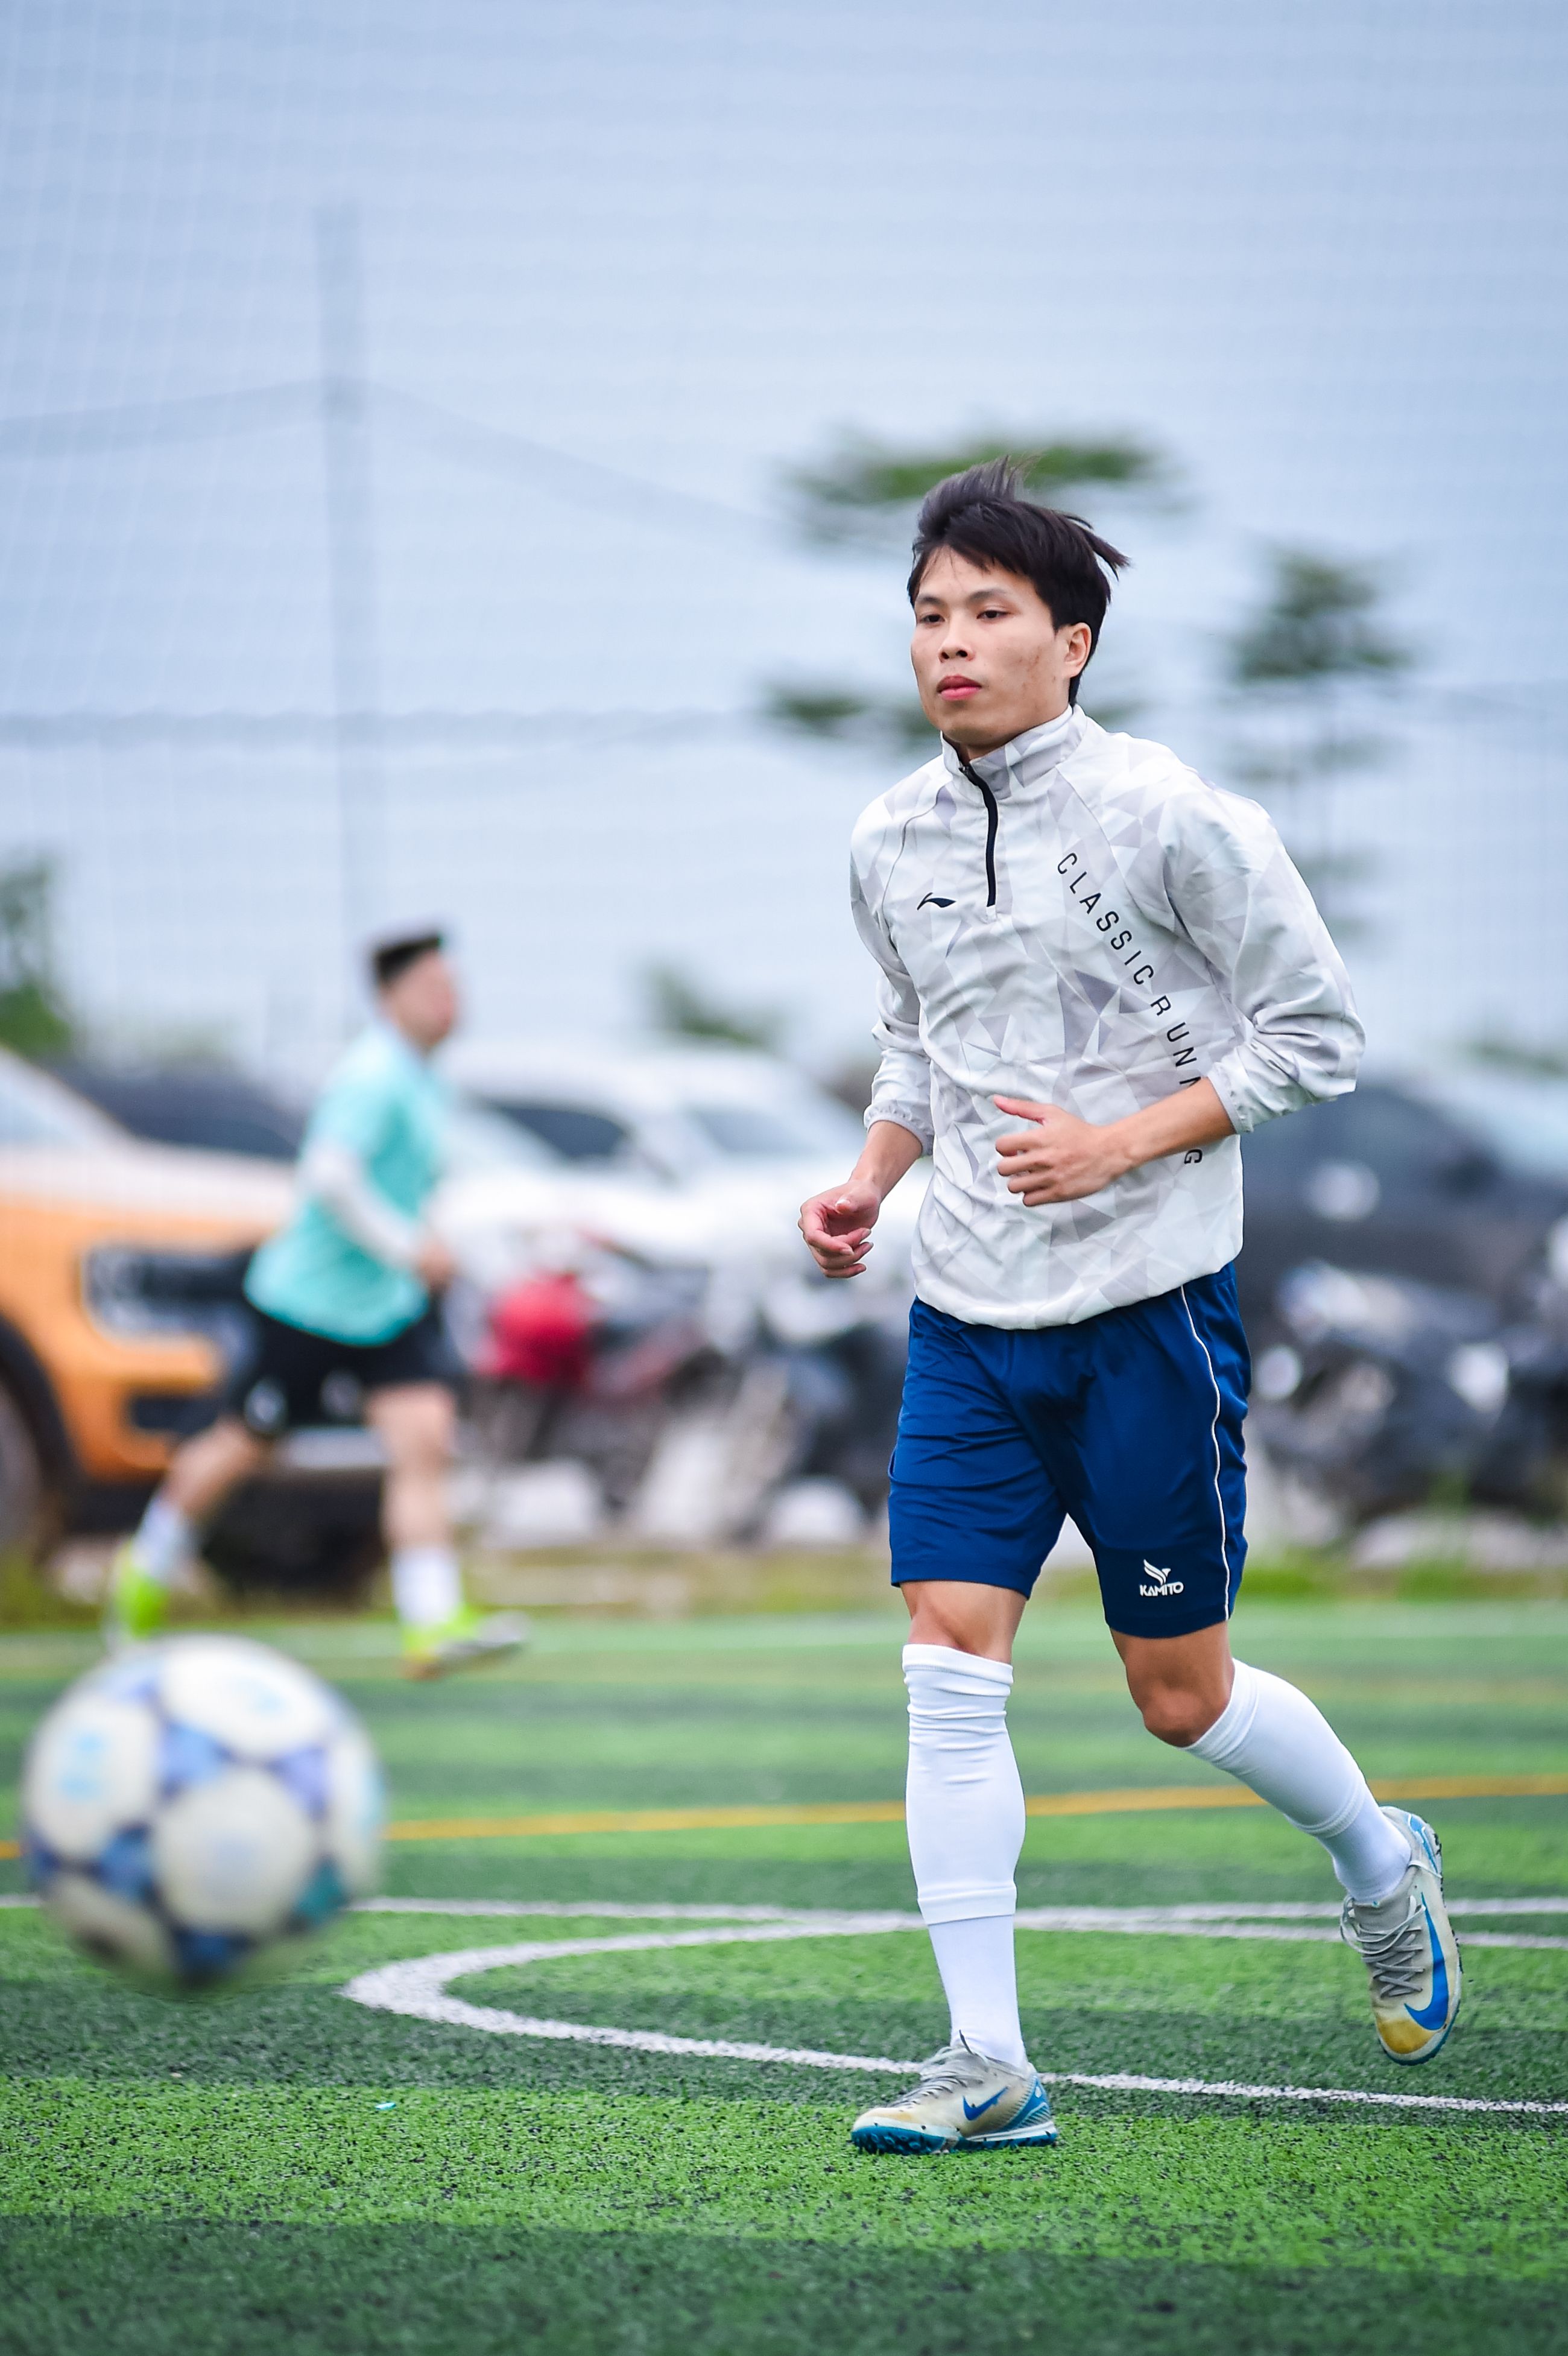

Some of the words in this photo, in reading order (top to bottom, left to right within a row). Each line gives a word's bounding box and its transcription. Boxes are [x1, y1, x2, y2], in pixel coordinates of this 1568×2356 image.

[1057, 852, 1154, 985] CLASSIC
[1150, 995, 1203, 1165] RUNG
[1139, 1581, 1184, 1597] KAMITO
